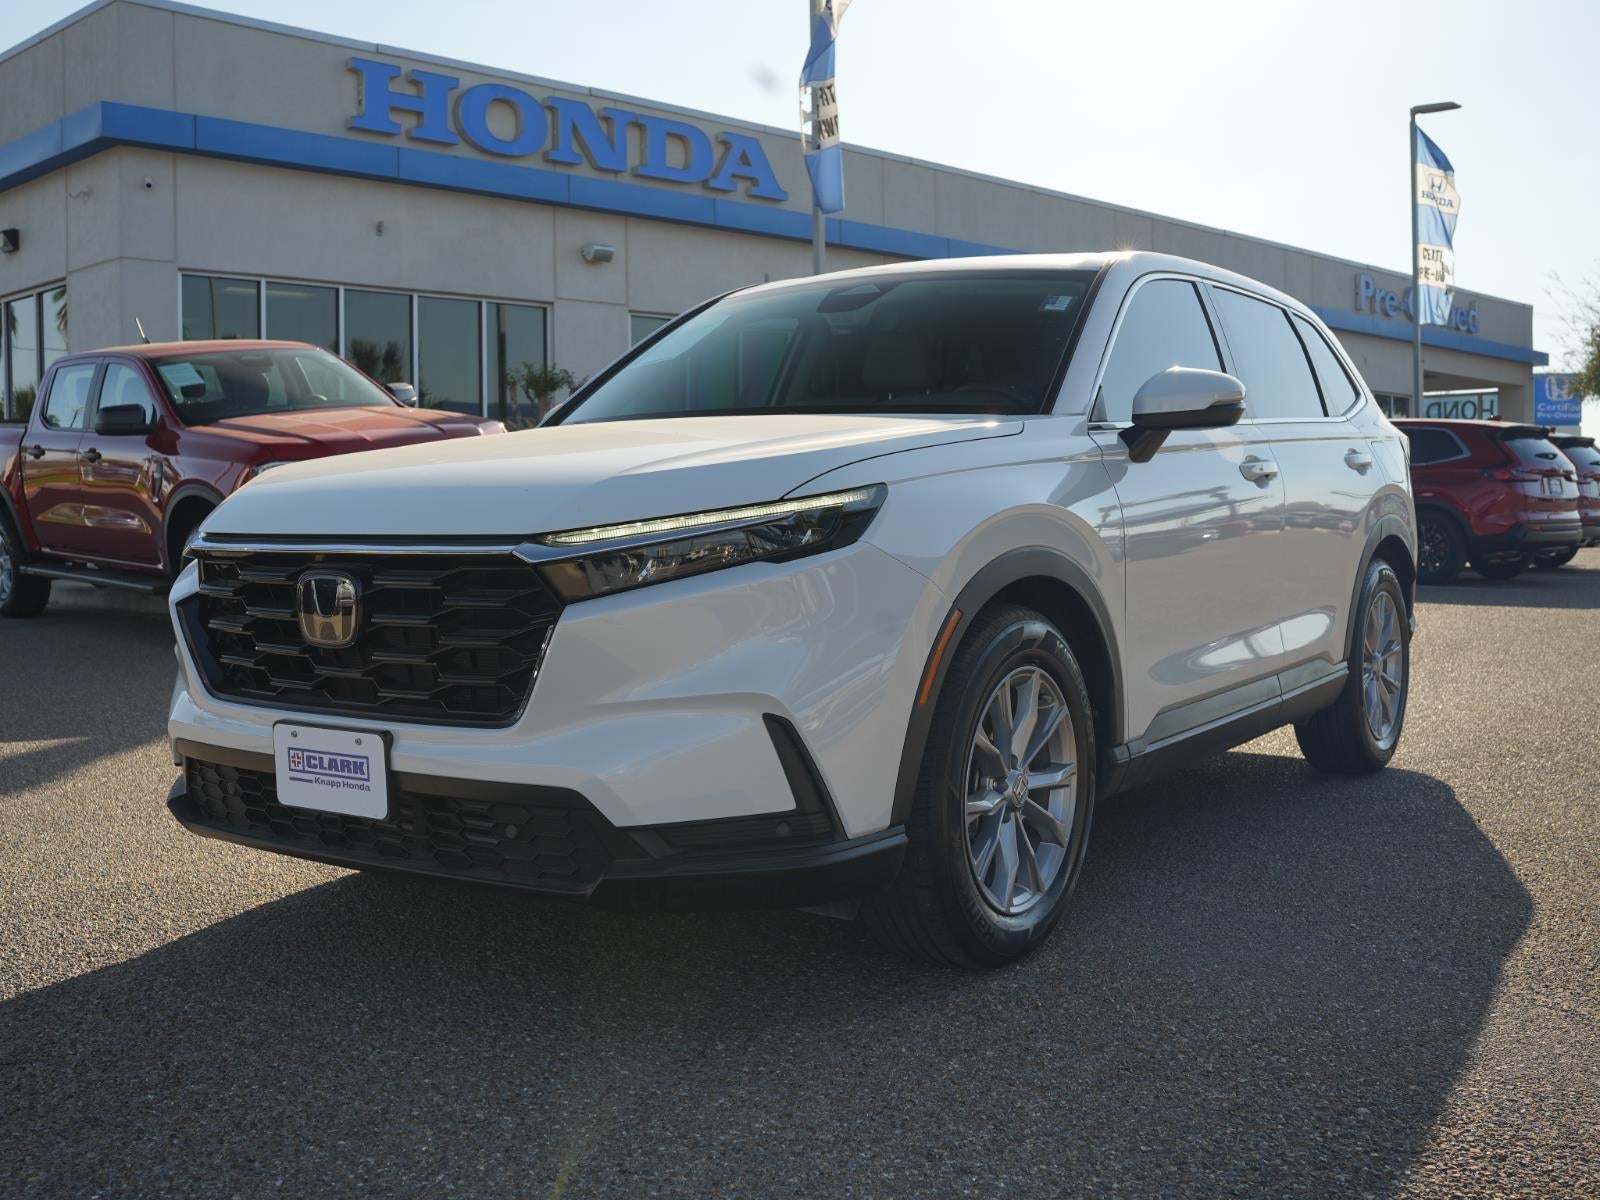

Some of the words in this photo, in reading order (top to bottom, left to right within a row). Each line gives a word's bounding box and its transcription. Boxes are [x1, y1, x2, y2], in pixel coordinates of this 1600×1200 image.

[348, 57, 788, 200] HONDA
[1421, 190, 1454, 208] HONDA
[306, 754, 366, 776] CLARK
[314, 776, 342, 789] Knapp
[342, 780, 371, 792] Honda
